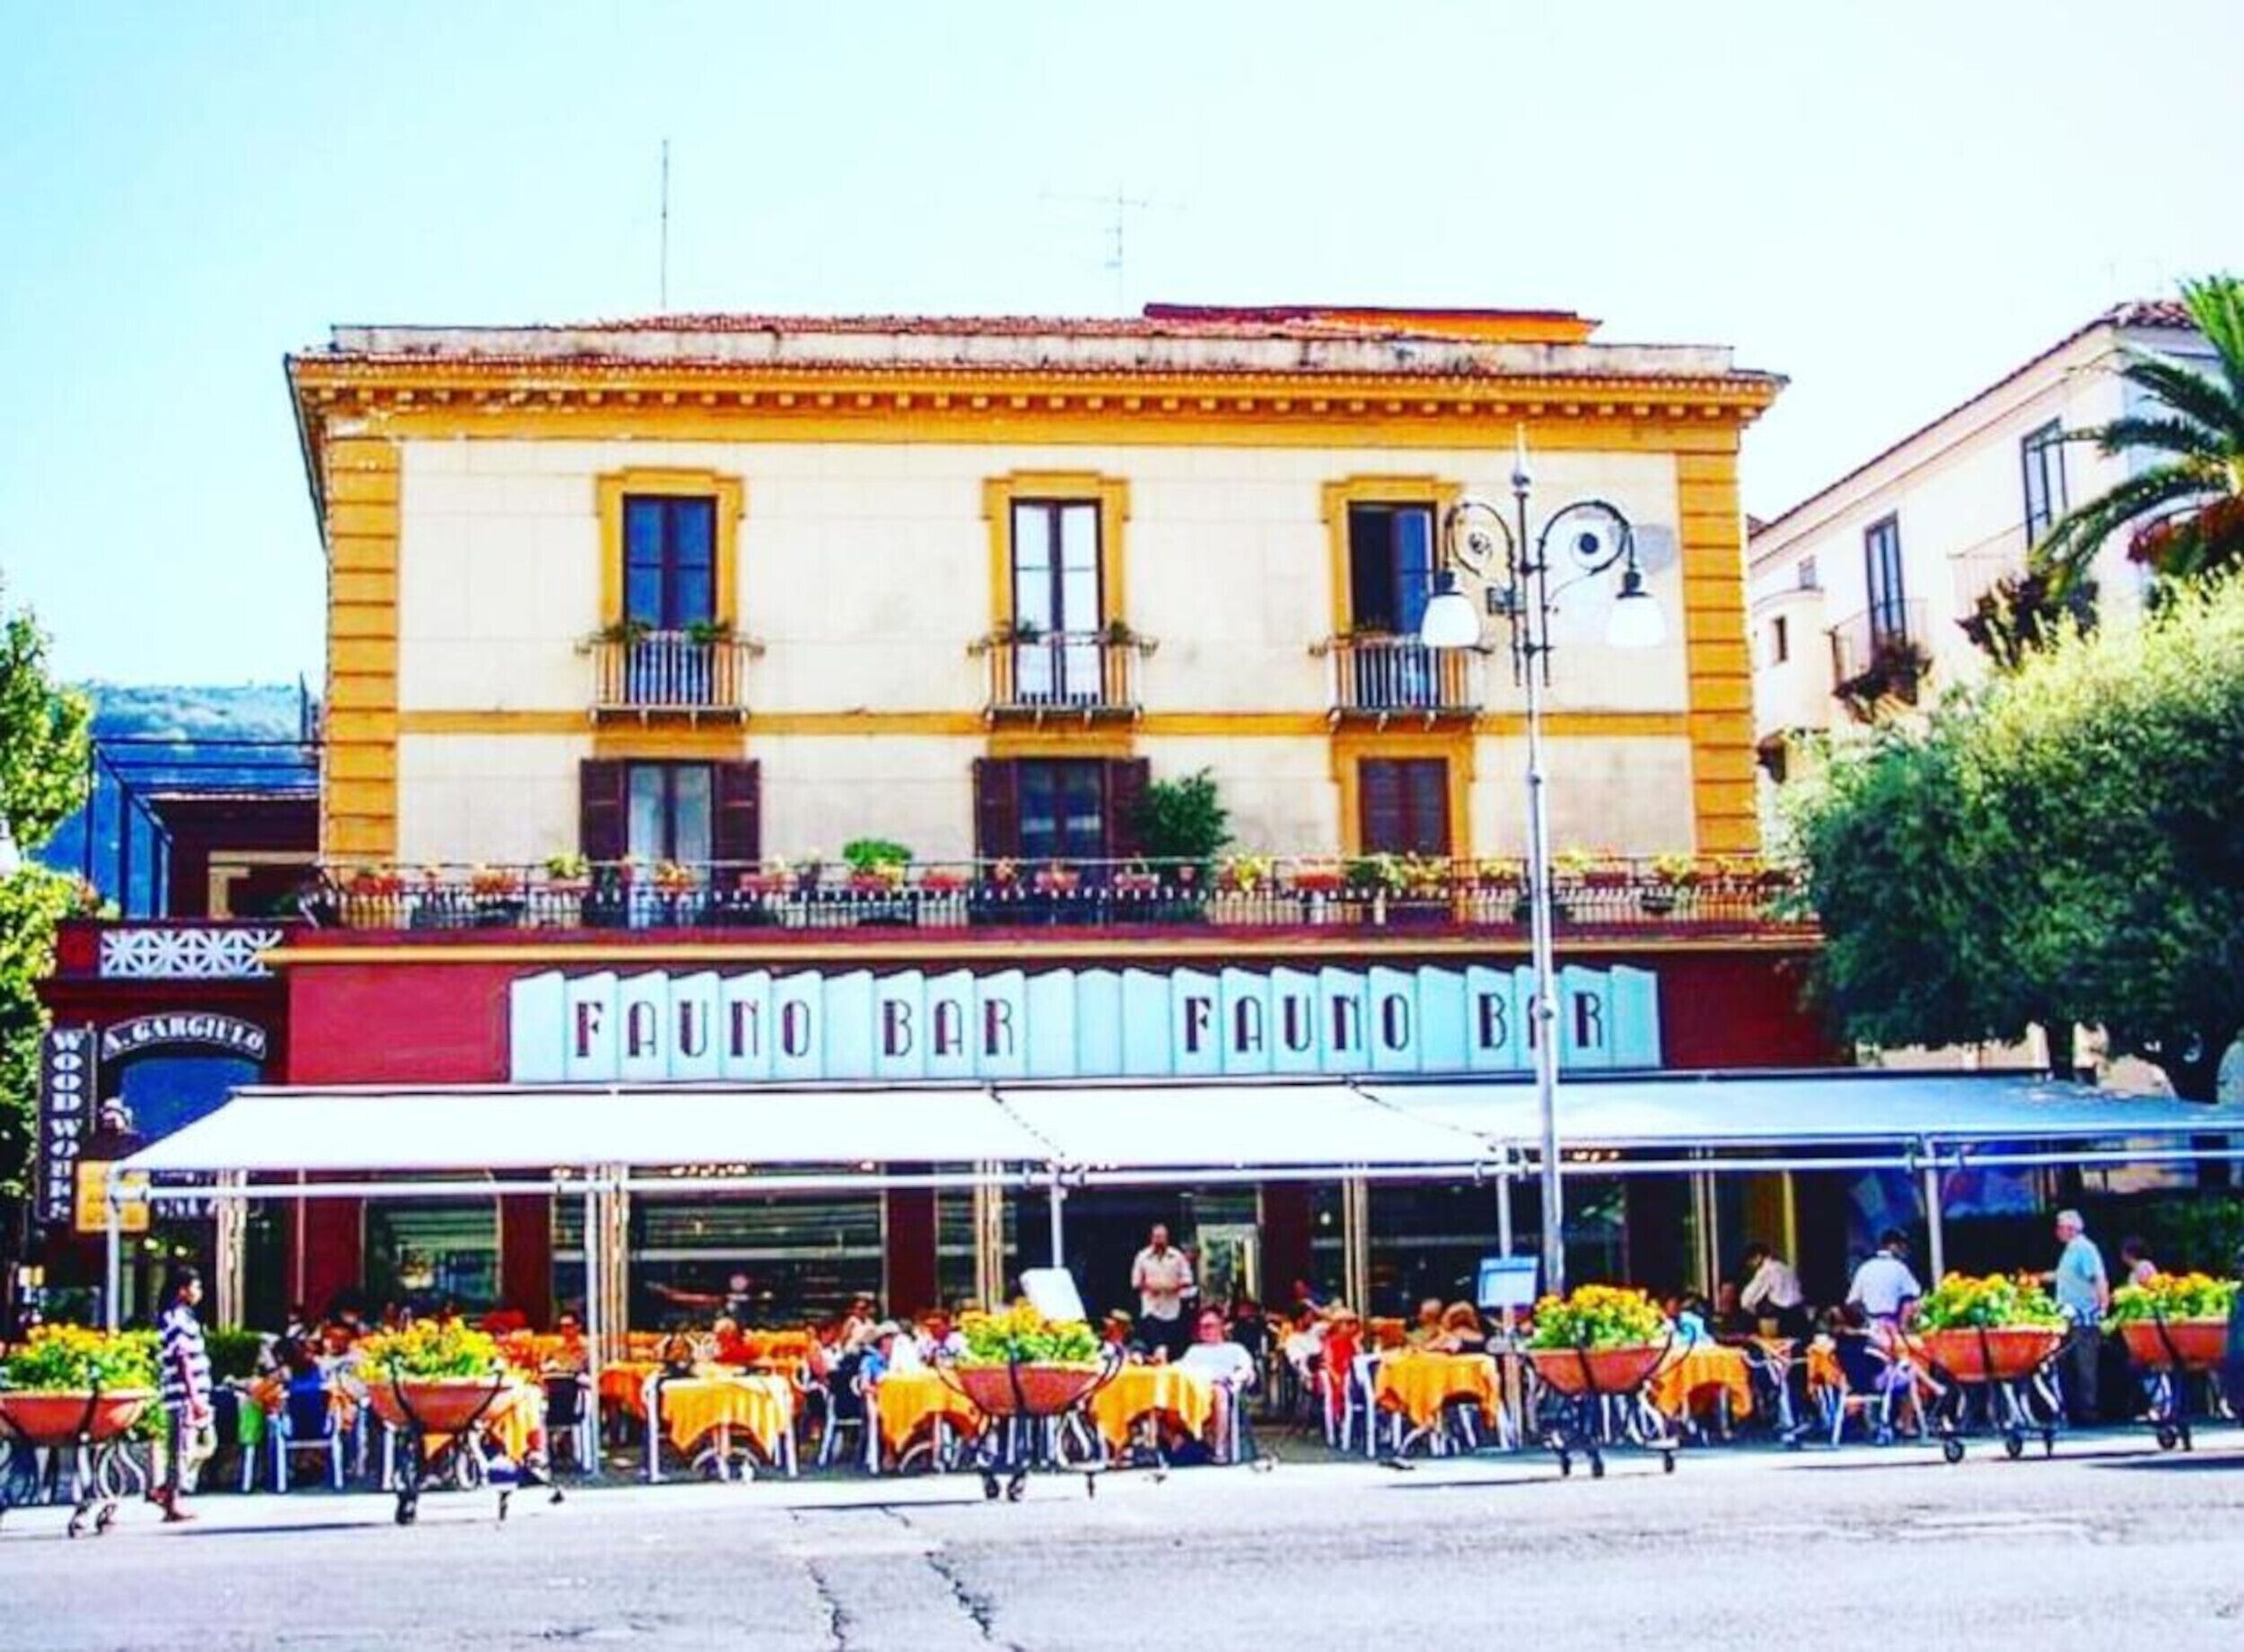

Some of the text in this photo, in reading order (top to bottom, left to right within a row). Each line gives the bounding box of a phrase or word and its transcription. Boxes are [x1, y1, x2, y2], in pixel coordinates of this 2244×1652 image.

[576, 999, 809, 1057] FAUNO
[881, 999, 1013, 1056] BAR
[1185, 993, 1409, 1053] FAUNO
